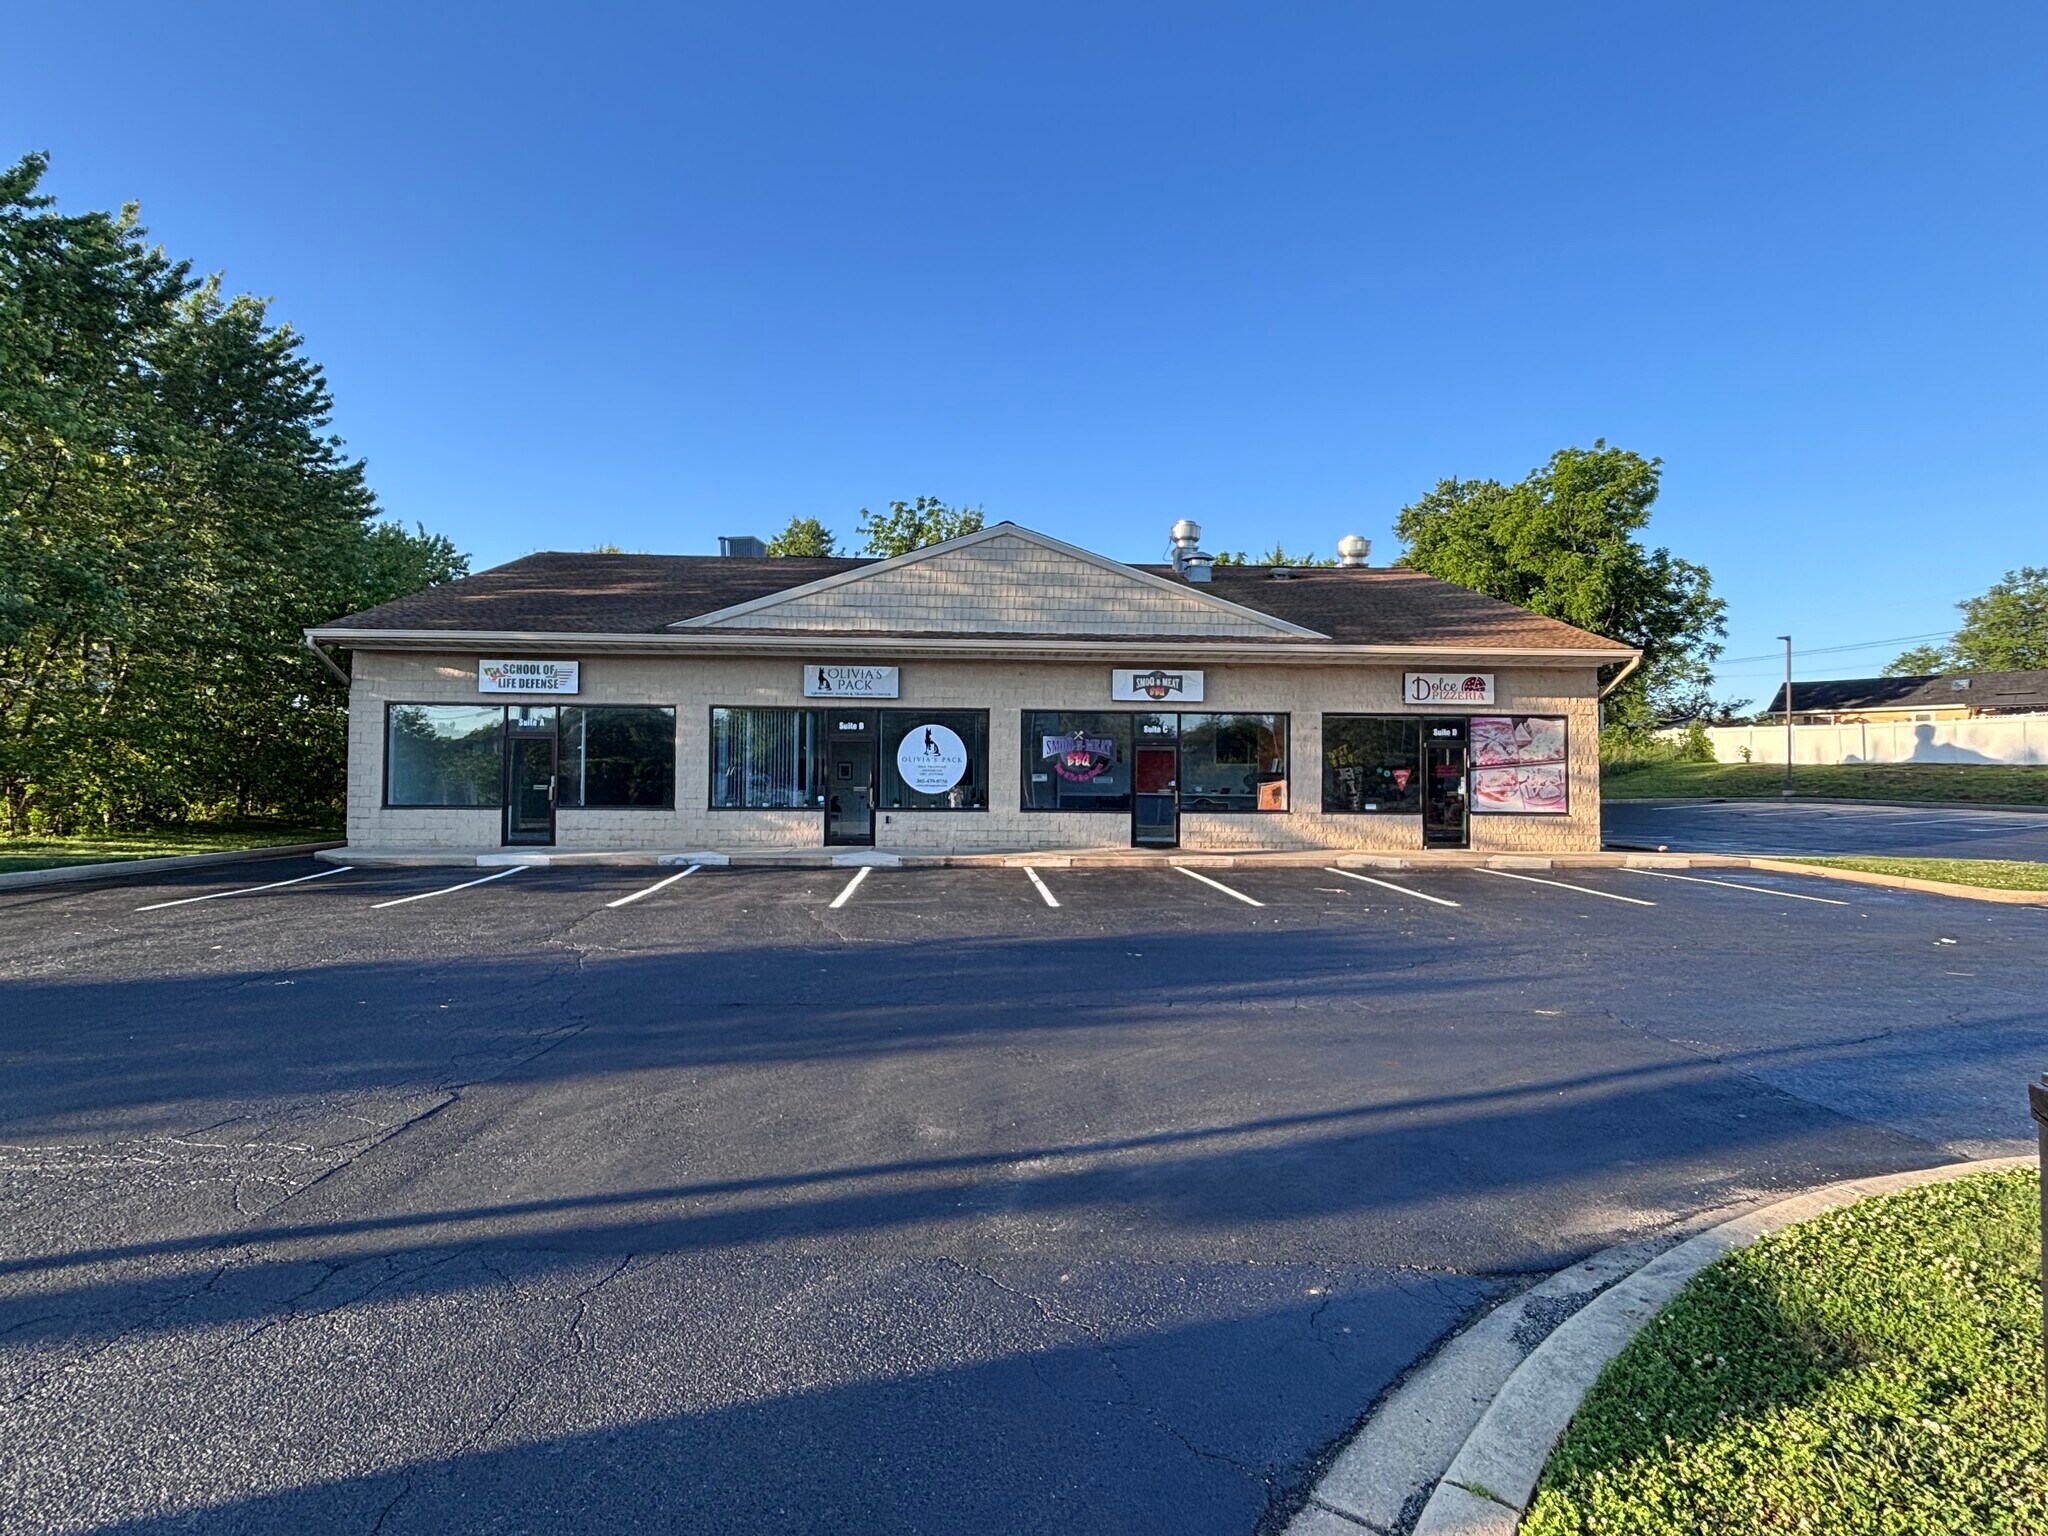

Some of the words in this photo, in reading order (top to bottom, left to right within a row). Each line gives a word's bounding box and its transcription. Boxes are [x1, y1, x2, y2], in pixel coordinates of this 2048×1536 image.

[503, 664, 541, 675] SCHOOL
[543, 664, 555, 675] OF
[828, 668, 882, 680] OLIVIA'S
[498, 678, 516, 688] LIFE
[519, 678, 559, 689] DEFENSE
[838, 680, 872, 690] PACK
[1136, 677, 1155, 688] SMOQ
[1162, 677, 1180, 689] MEAT
[1412, 676, 1458, 700] Dolce
[1432, 692, 1485, 700] PIZZERIA
[518, 718, 537, 727] Suite
[540, 718, 545, 727] A
[839, 721, 857, 730] Suite
[858, 721, 865, 730] B
[1143, 725, 1161, 734] Suite
[1162, 725, 1168, 734] C
[1433, 728, 1451, 737] Suite
[1452, 728, 1458, 737] D
[1085, 739, 1113, 756] MEAT
[1067, 752, 1091, 767] BBQ
